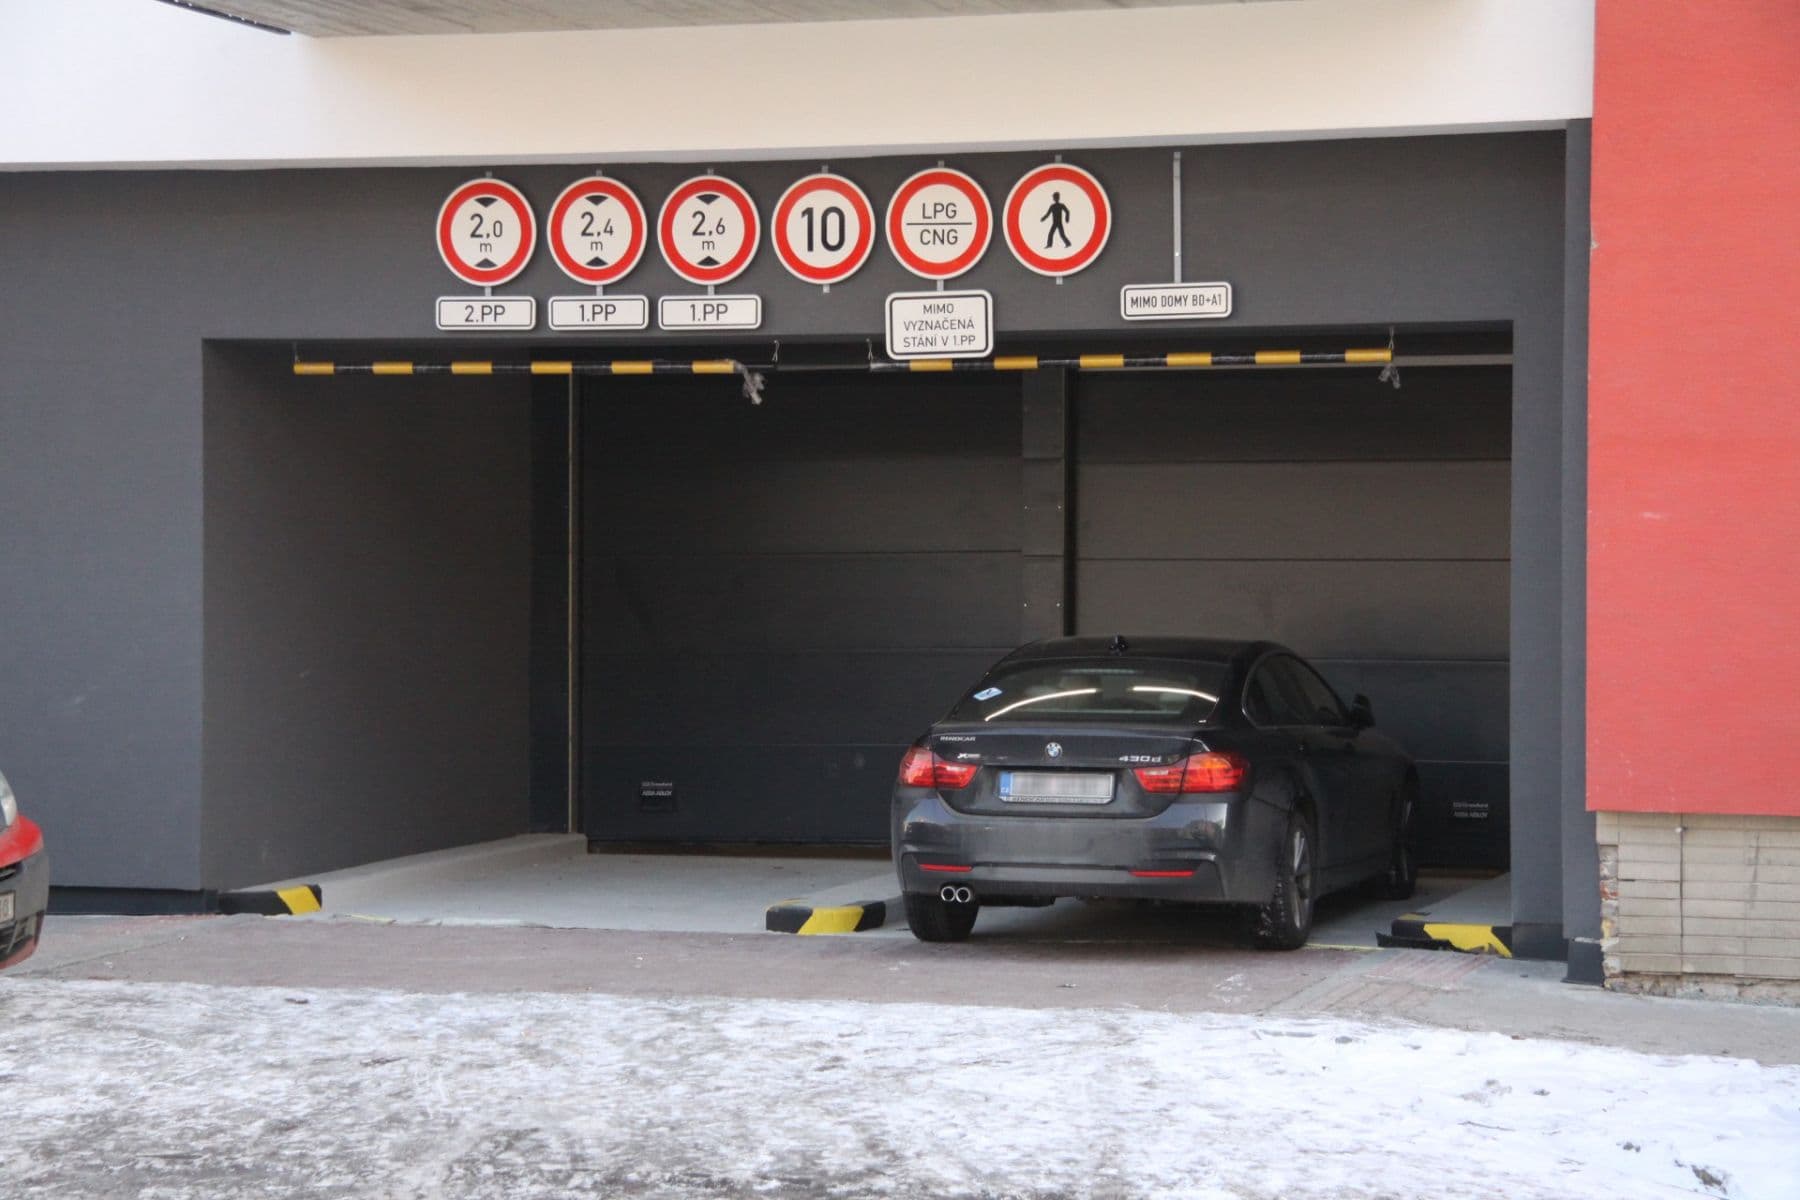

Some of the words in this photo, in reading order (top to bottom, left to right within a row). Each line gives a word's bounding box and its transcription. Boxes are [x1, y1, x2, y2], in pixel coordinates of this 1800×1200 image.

[922, 202, 957, 220] LPG
[469, 213, 503, 239] 2,0
[580, 211, 614, 237] 2,4
[691, 211, 726, 237] 2,6
[801, 206, 846, 252] 10
[590, 240, 603, 252] m
[702, 239, 715, 251] m
[919, 228, 958, 246] CNG
[479, 241, 492, 253] m
[923, 303, 954, 314] MIMO
[1130, 296, 1157, 308] MIMO
[1161, 295, 1188, 307] DOMY
[464, 305, 506, 323] 2.PP
[578, 304, 616, 322] 1.PP
[689, 304, 728, 322] 1.PP
[903, 316, 975, 331] VYZNAČENÁ
[903, 334, 937, 348] STÁNÍ
[941, 336, 949, 347] V
[953, 335, 976, 346] 1.PP
[1119, 755, 1161, 763] 430d
